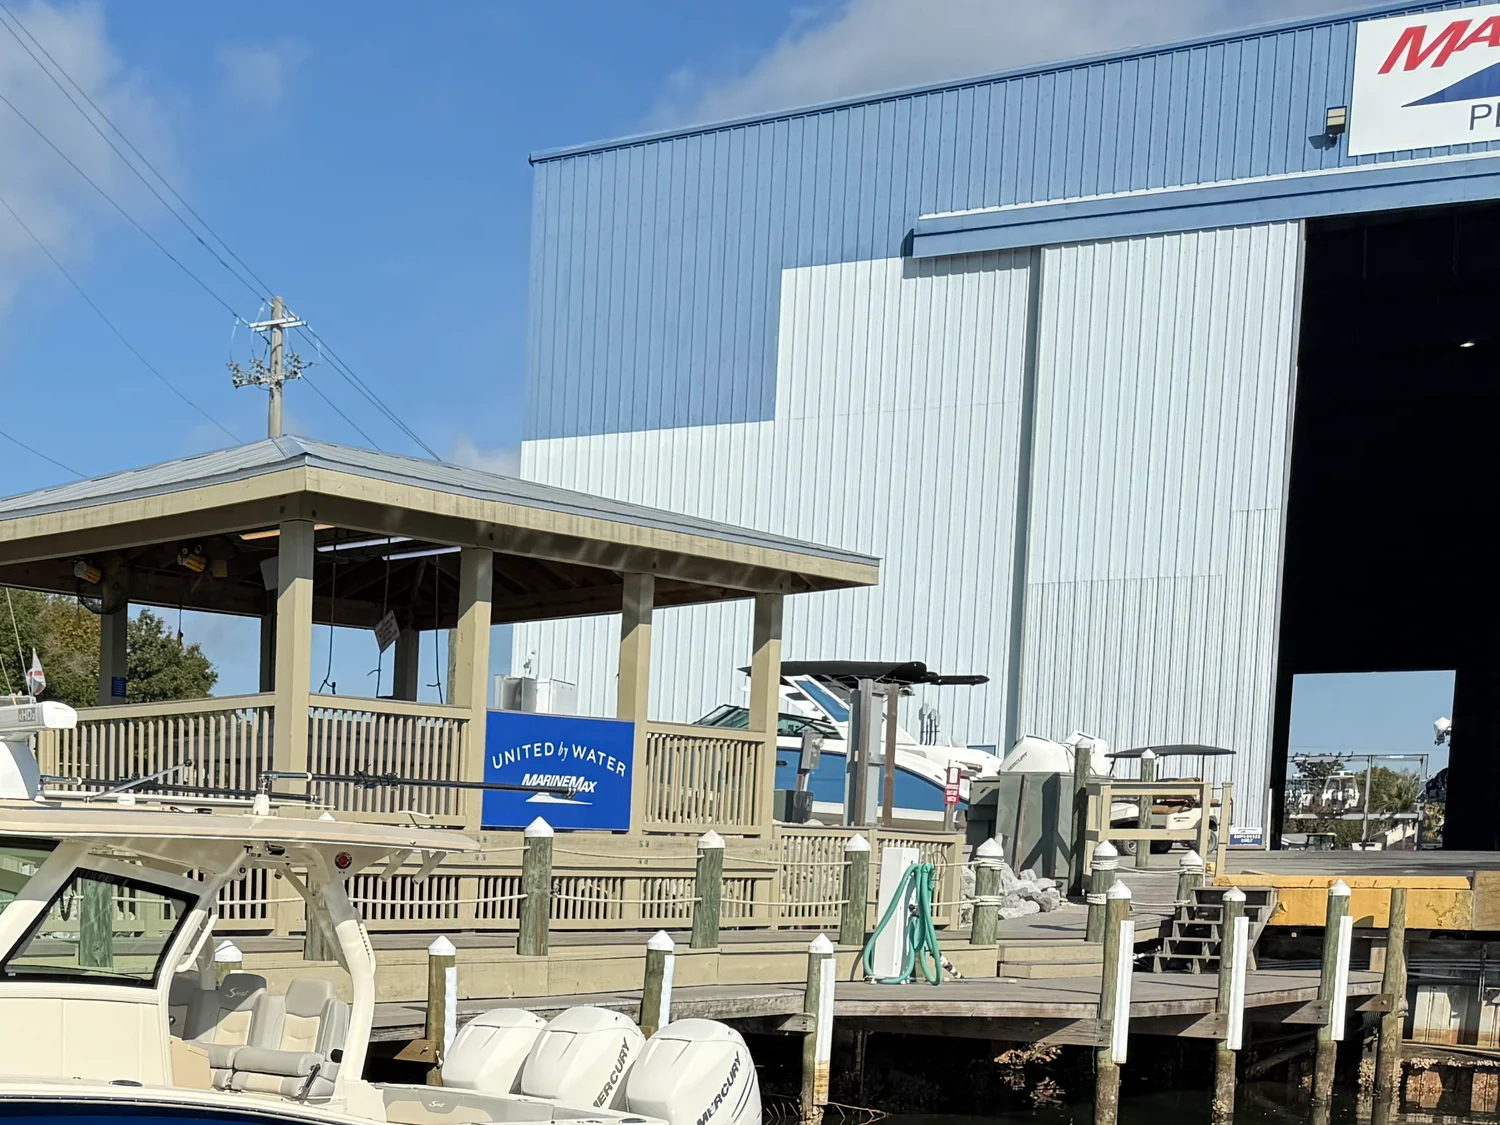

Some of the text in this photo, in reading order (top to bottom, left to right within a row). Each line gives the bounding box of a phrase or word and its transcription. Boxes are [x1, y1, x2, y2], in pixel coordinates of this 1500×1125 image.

[1469, 103, 1500, 131] P
[492, 741, 626, 777] UNITED by WATER
